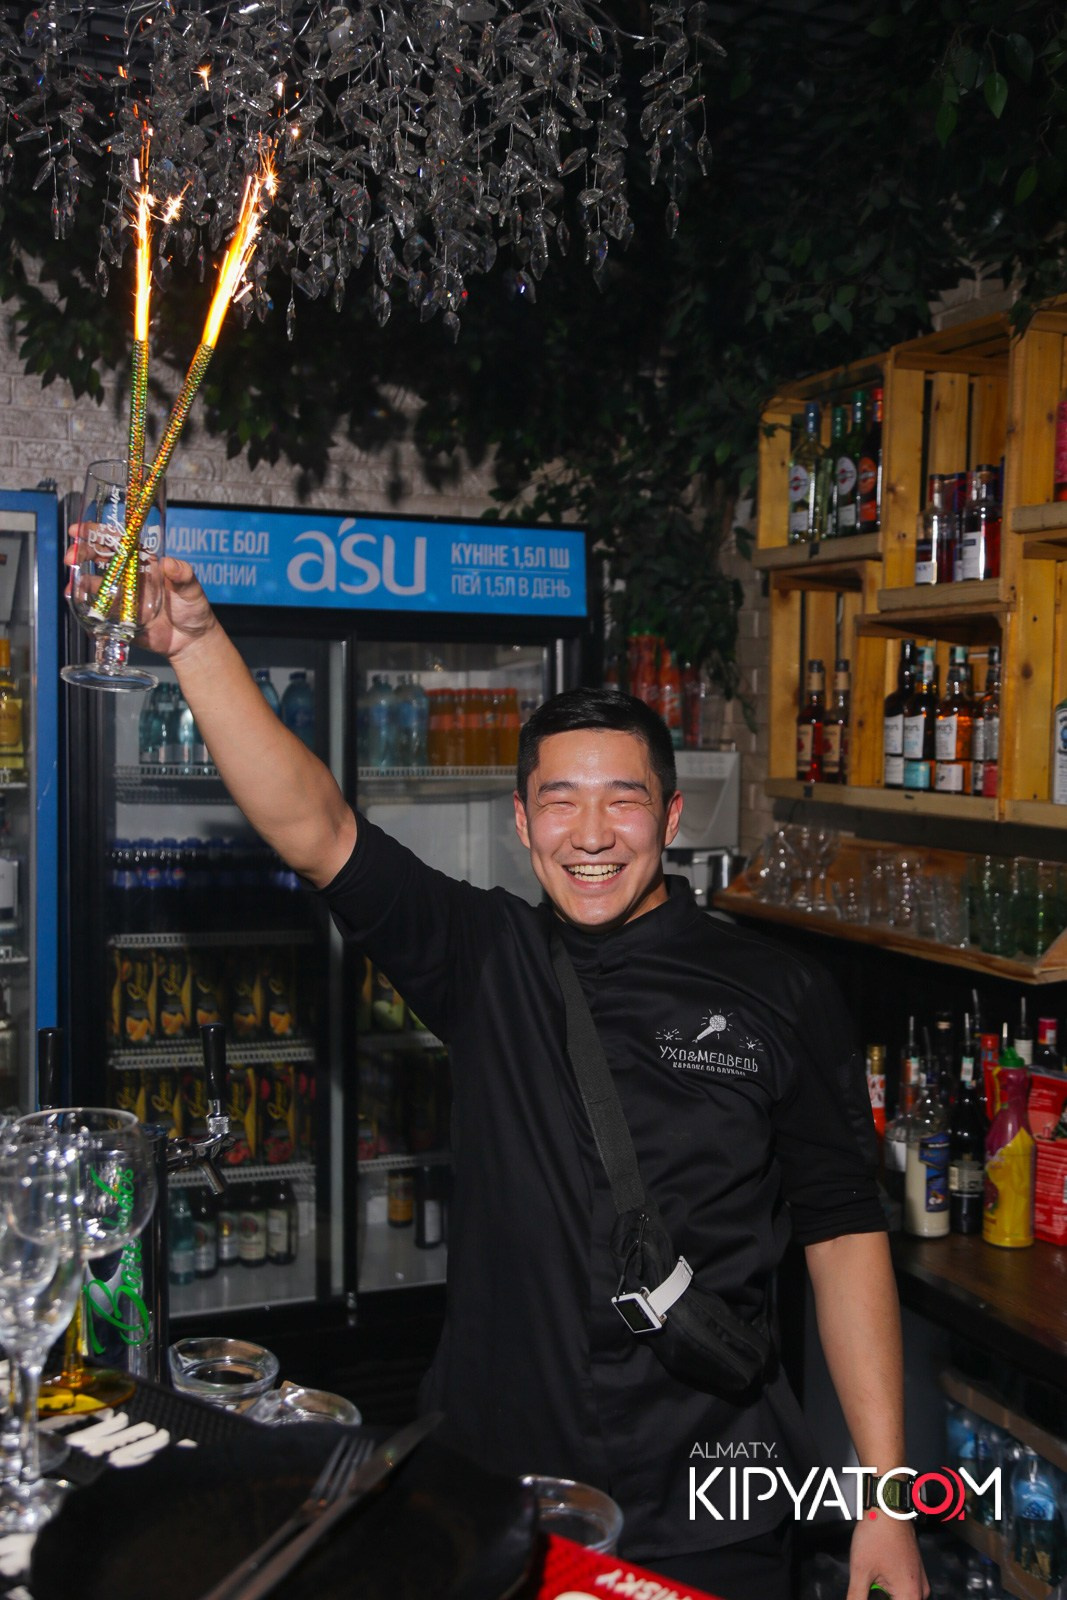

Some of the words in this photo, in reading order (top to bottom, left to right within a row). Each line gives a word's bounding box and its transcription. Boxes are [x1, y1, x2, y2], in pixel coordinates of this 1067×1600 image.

[233, 530, 269, 555] БОЛ
[451, 571, 481, 595] ПЕЙ
[518, 577, 529, 597] В
[532, 577, 571, 599] ДЕНЬ
